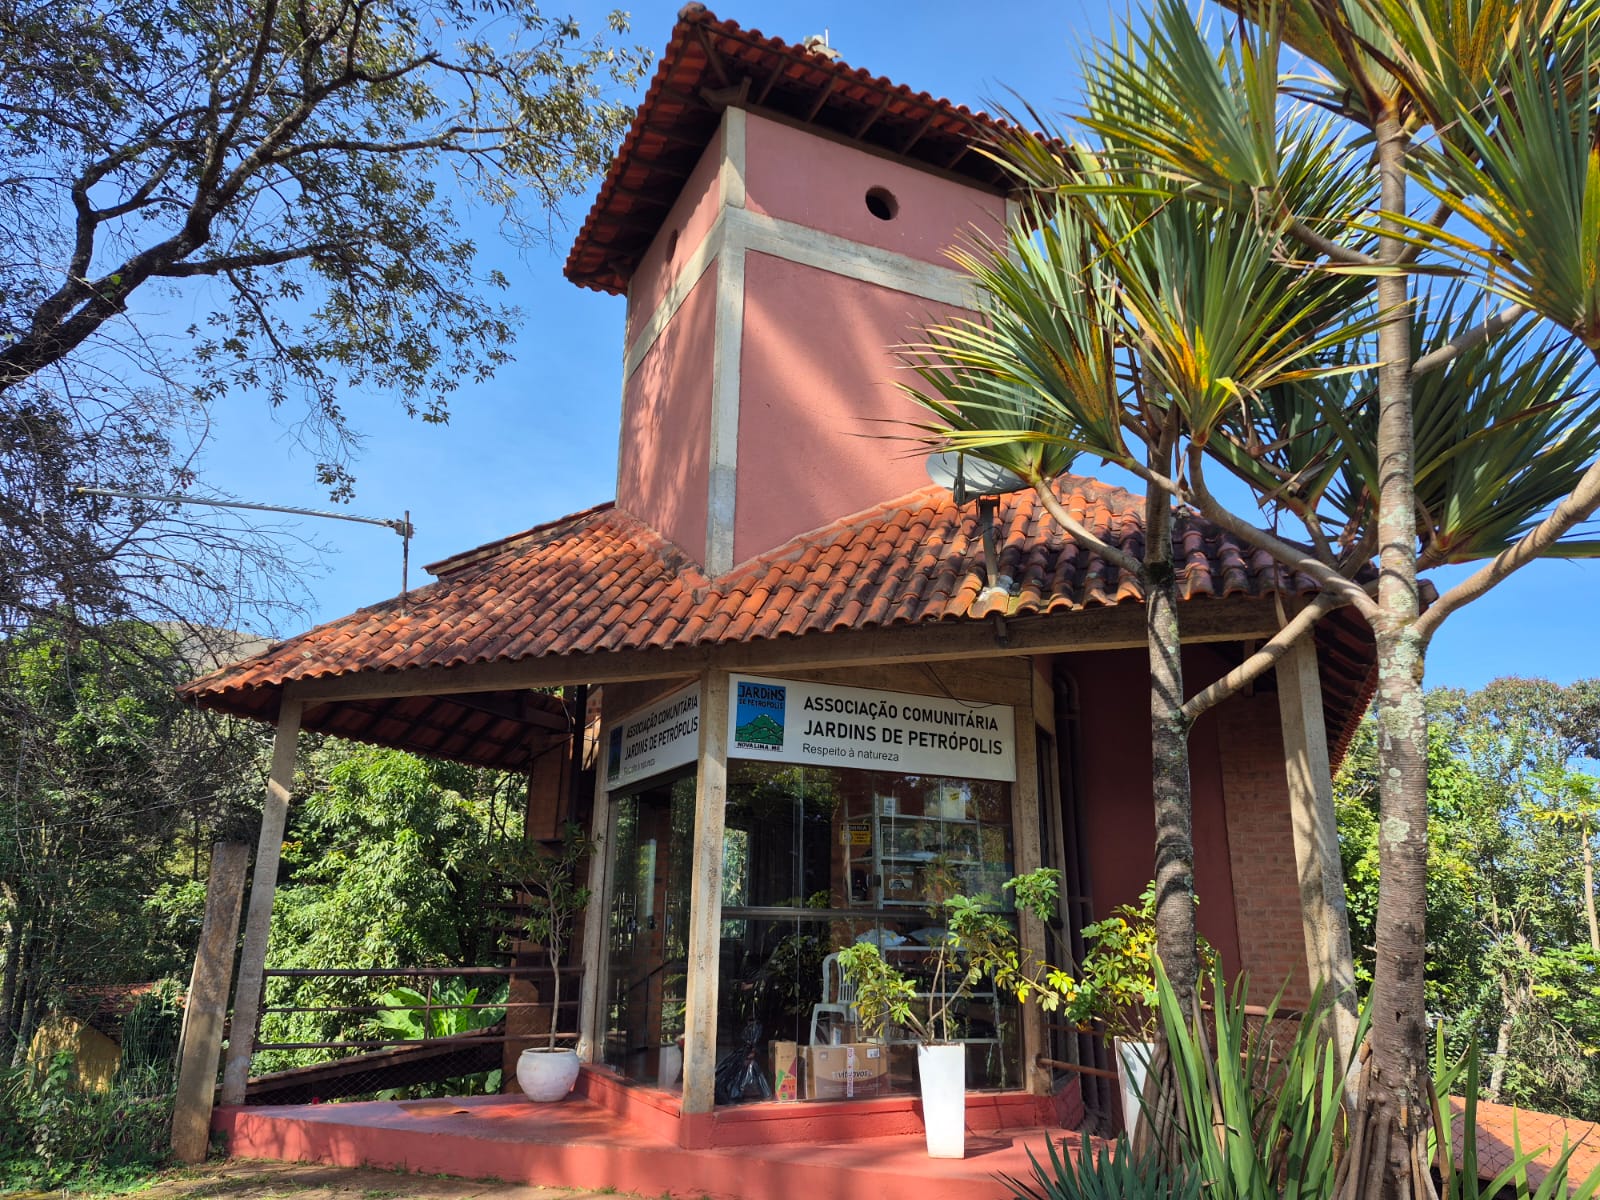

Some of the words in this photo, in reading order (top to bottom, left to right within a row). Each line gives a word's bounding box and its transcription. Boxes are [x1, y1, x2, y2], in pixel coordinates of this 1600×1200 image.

[627, 712, 657, 738] ASSOCIAÇÃO
[658, 696, 698, 724] COMUNITÁRIA
[804, 696, 898, 721] ASSOCIAÇÃO
[903, 708, 999, 732] COMUNITÁRIA
[625, 738, 648, 760] JARDINS
[649, 736, 657, 750] DE
[658, 716, 698, 747] PETRÓPOLIS
[802, 743, 846, 758] Respeito
[848, 747, 855, 758] à
[857, 751, 899, 762] natureza
[804, 720, 877, 742] JARDINS
[882, 728, 903, 745] DE
[909, 731, 1003, 756] PETRÓPOLIS
